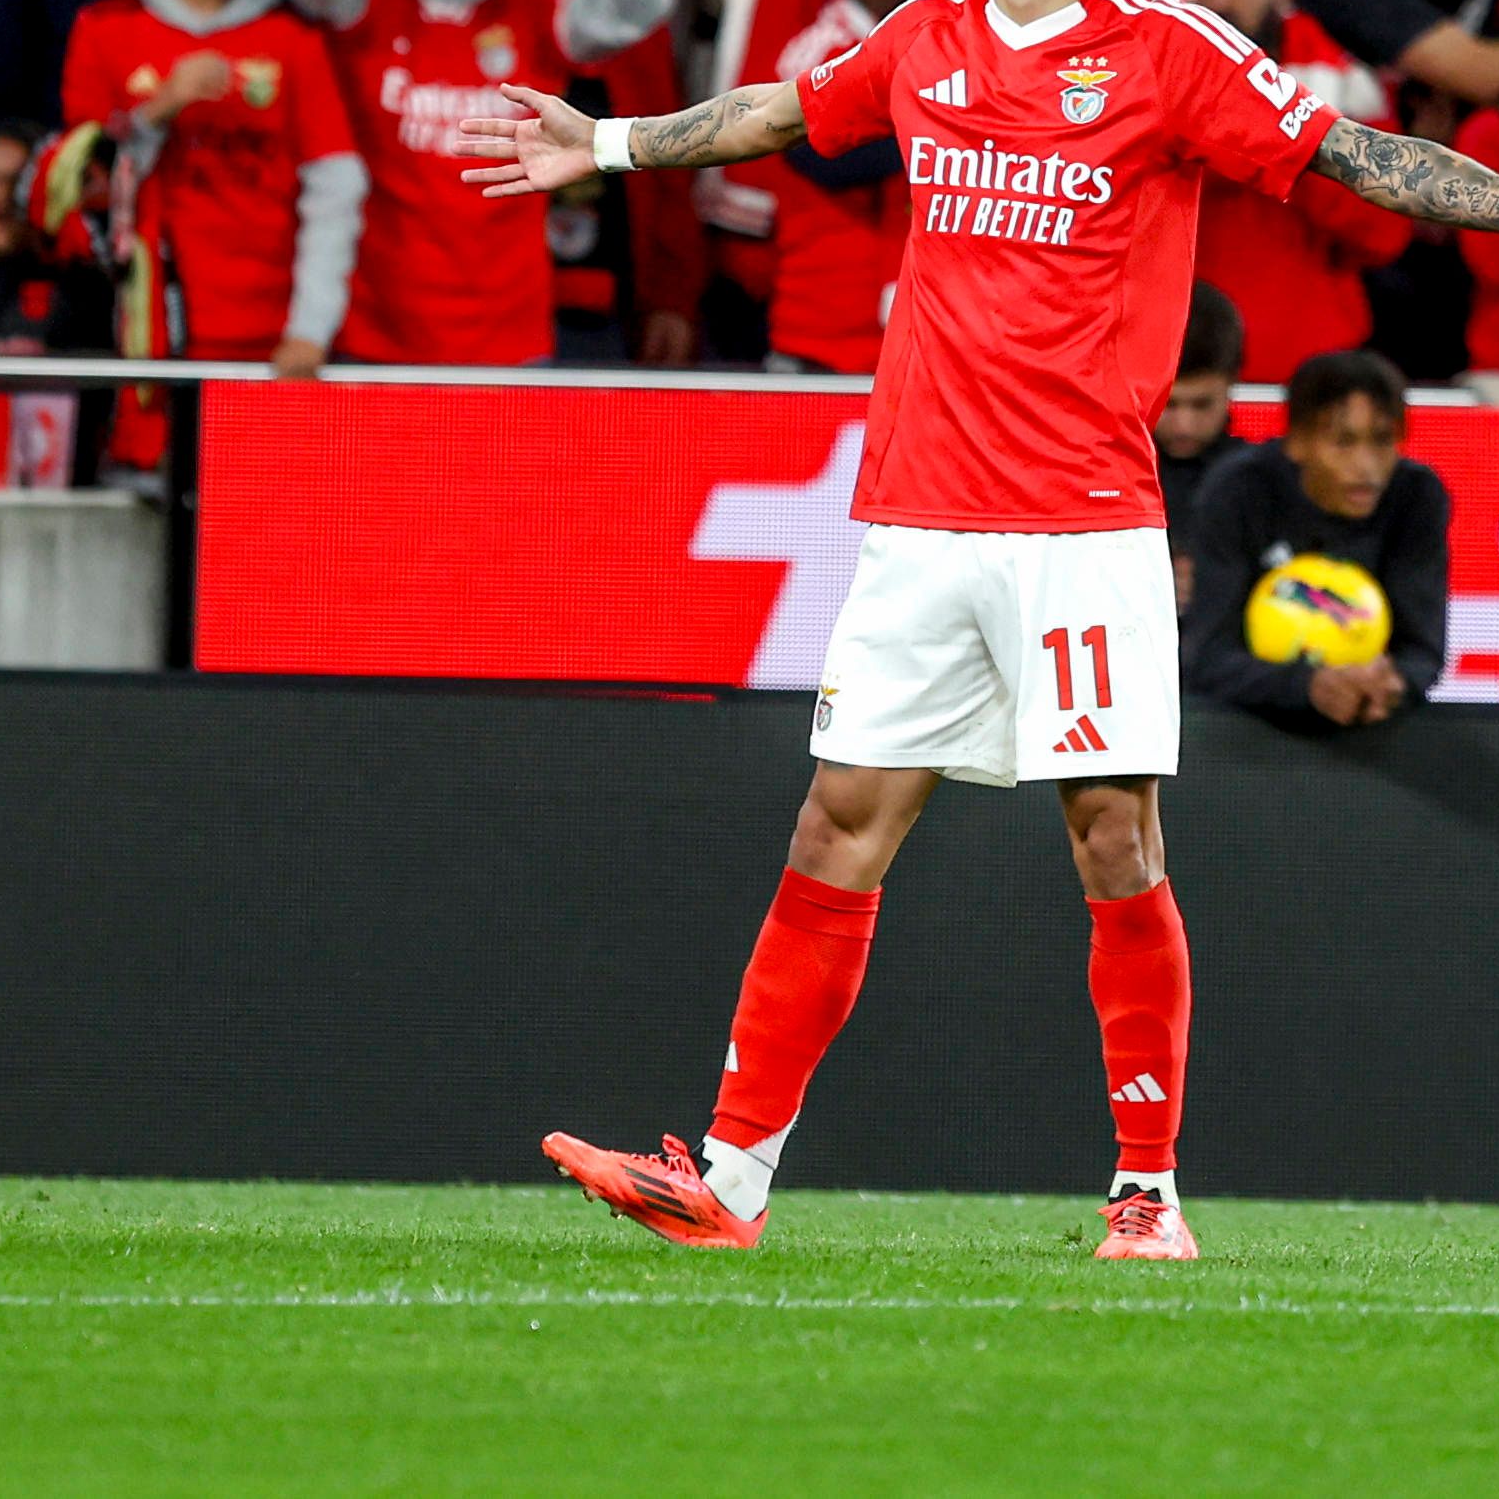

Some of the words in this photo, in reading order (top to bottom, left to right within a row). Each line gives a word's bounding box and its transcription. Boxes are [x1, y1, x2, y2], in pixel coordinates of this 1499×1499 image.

[908, 136, 1113, 204] Emirates
[925, 193, 971, 234] FLY
[970, 196, 1075, 246] BETTER
[1041, 624, 1113, 711] 11
